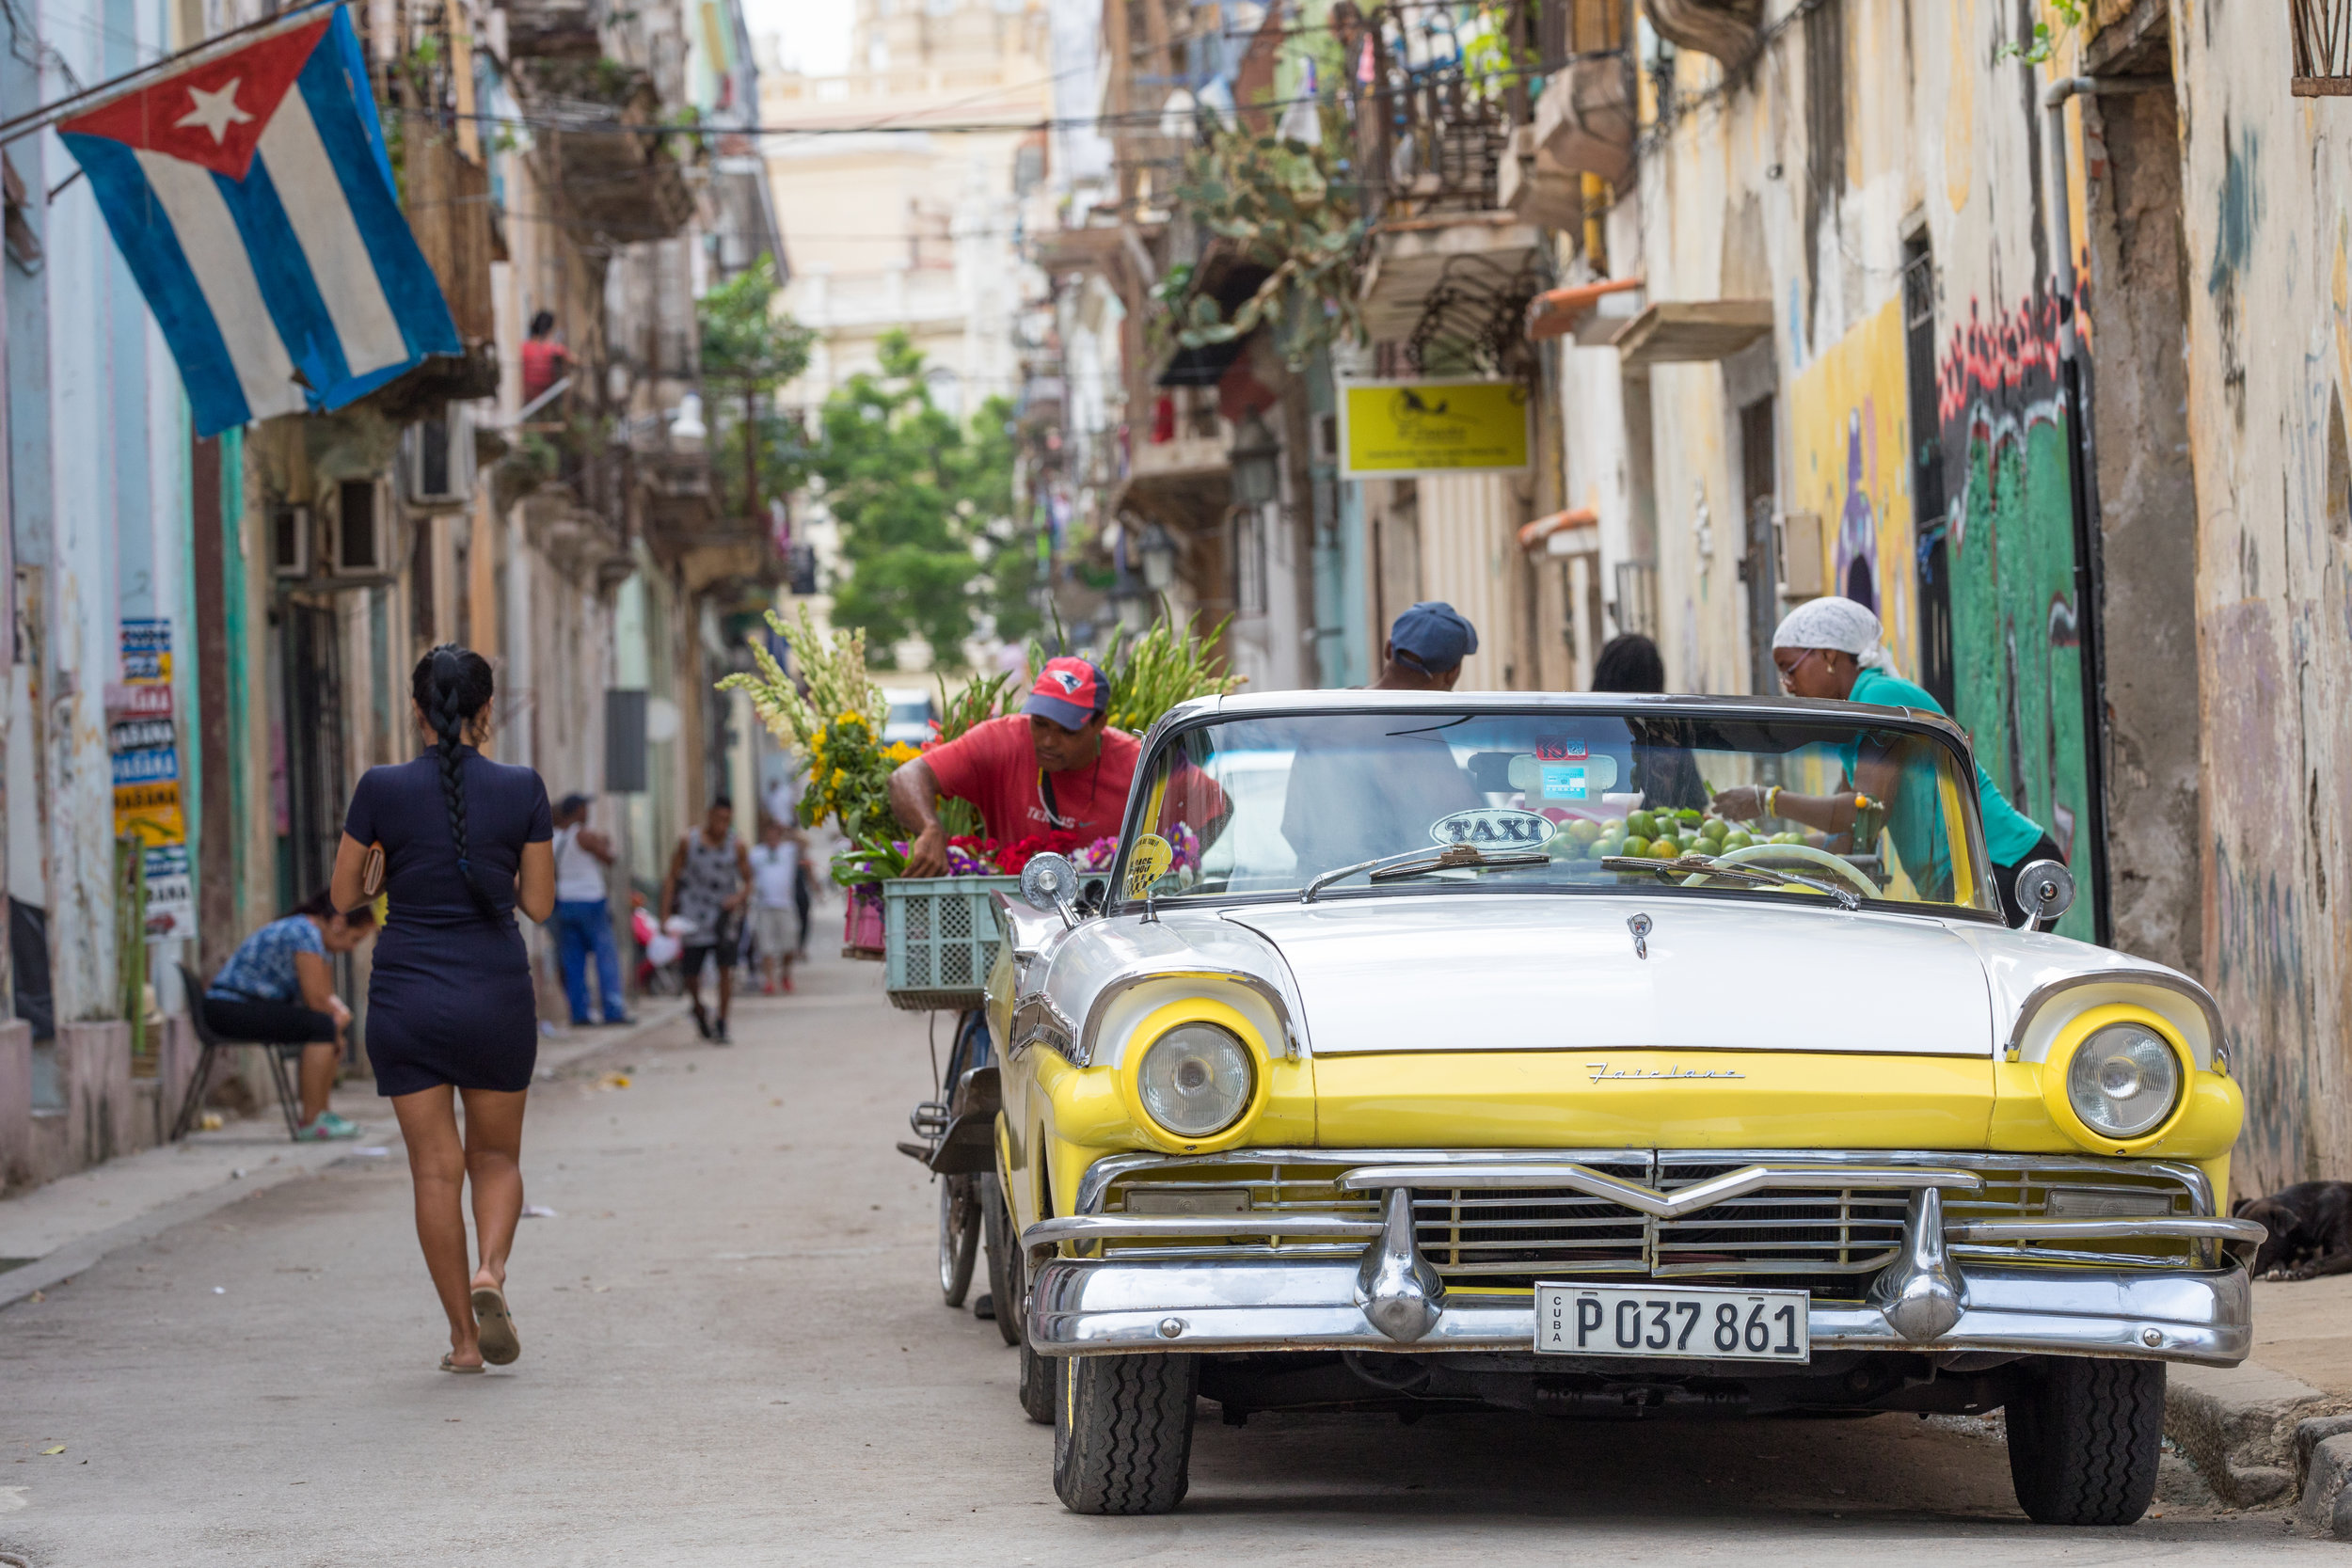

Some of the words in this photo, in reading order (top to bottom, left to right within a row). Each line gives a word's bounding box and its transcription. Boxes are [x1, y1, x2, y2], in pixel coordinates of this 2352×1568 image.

[1445, 817, 1543, 844] TAXI
[1585, 1062, 1746, 1084] Fairlane
[1552, 1296, 1562, 1342] CUBA
[1576, 1298, 1603, 1347] P
[1615, 1299, 1702, 1351] 037
[1715, 1302, 1800, 1354] 861
